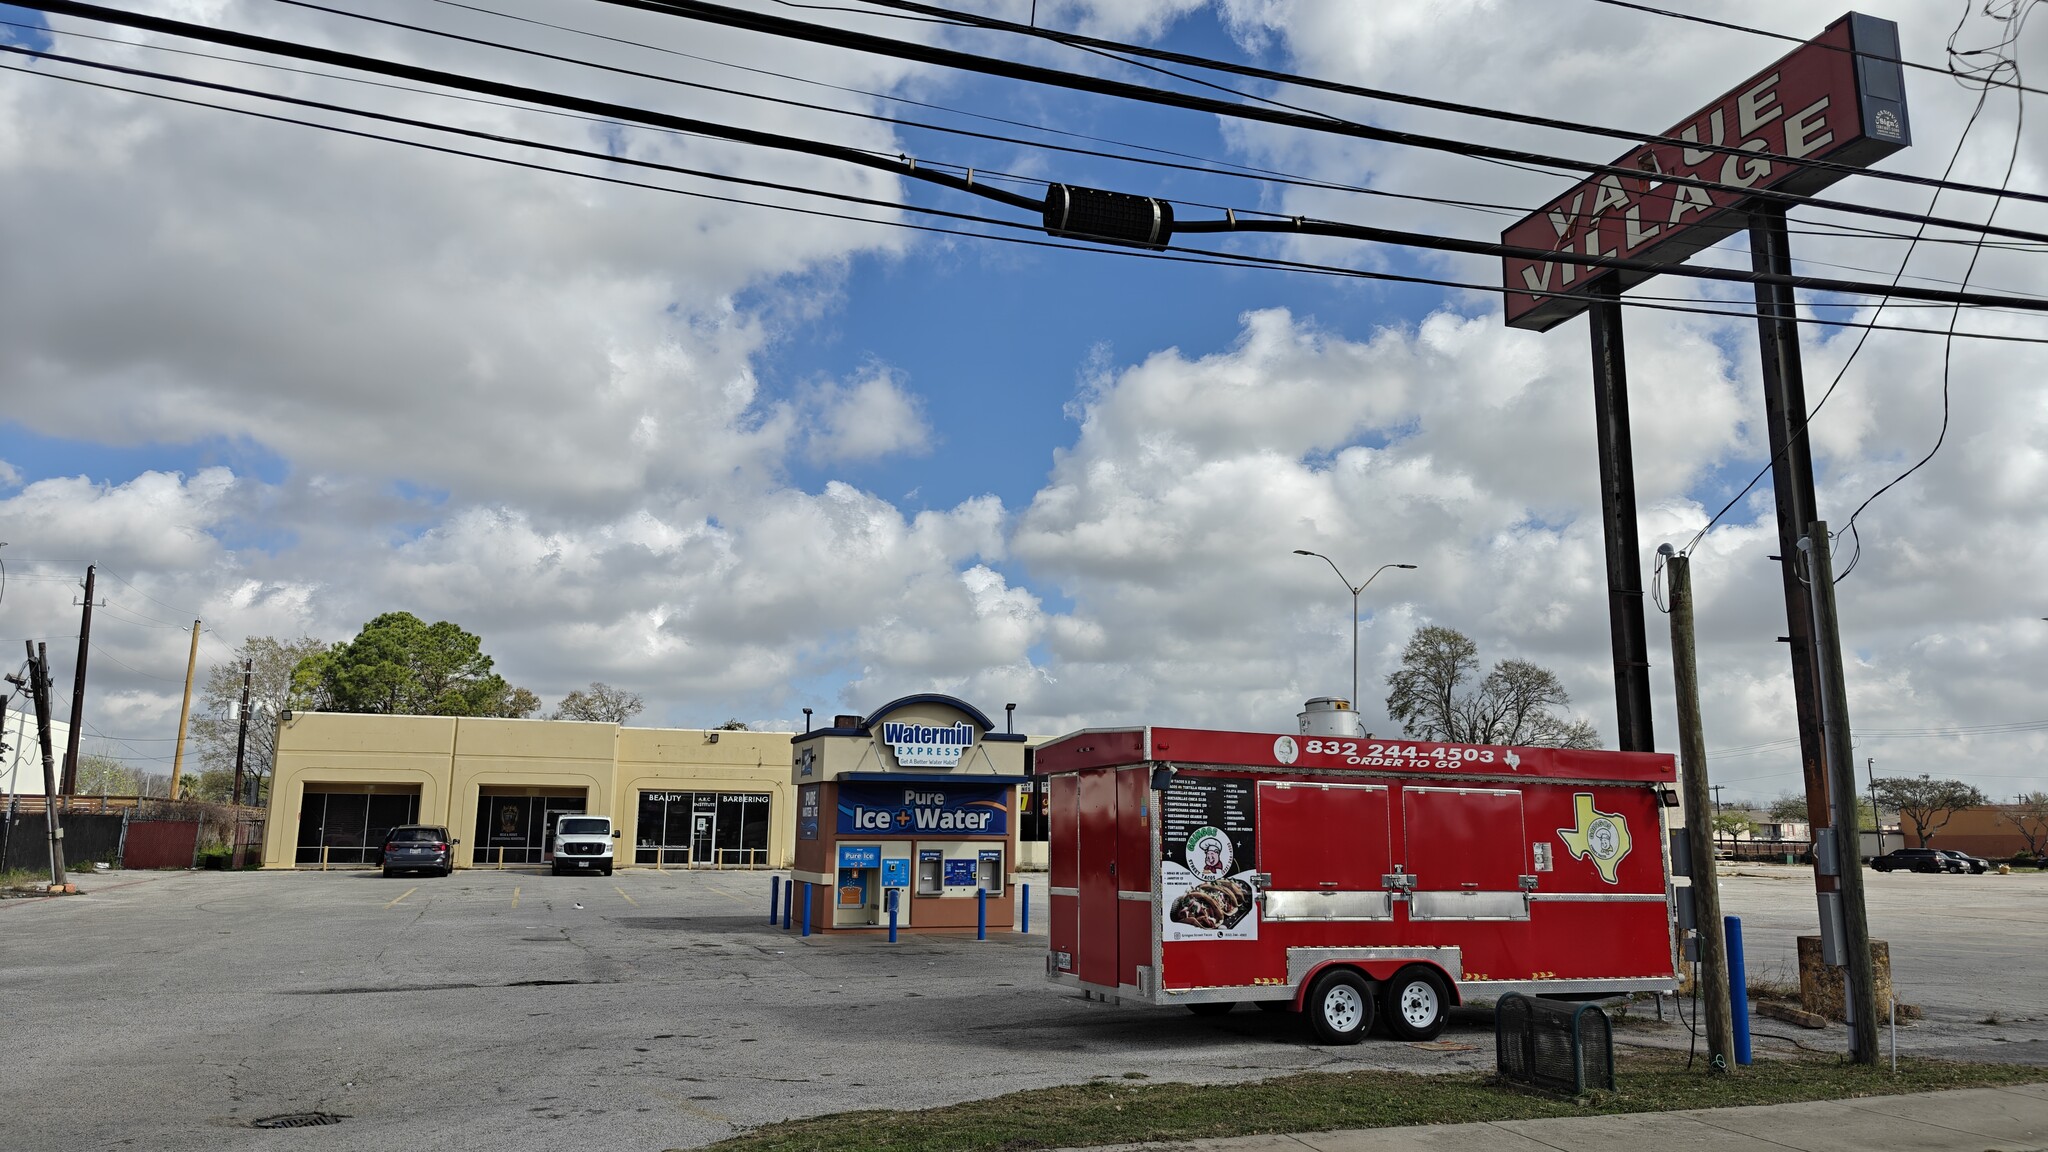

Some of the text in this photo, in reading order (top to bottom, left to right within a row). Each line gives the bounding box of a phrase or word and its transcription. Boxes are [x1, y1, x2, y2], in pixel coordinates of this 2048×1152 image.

[1547, 71, 1783, 243] VAUE
[1521, 94, 1835, 301] VILLAGE
[885, 722, 973, 745] Watermill
[898, 746, 960, 756] EXPRESS
[1305, 740, 1495, 763] 832 244-4503
[1346, 756, 1461, 769] ORDER TO GO
[805, 791, 816, 806] PURE
[904, 790, 944, 805] Pure
[855, 807, 890, 828] Ice
[915, 808, 990, 829] Water
[1186, 826, 1218, 852] GRINGOS
[1188, 858, 1200, 876] STREET
